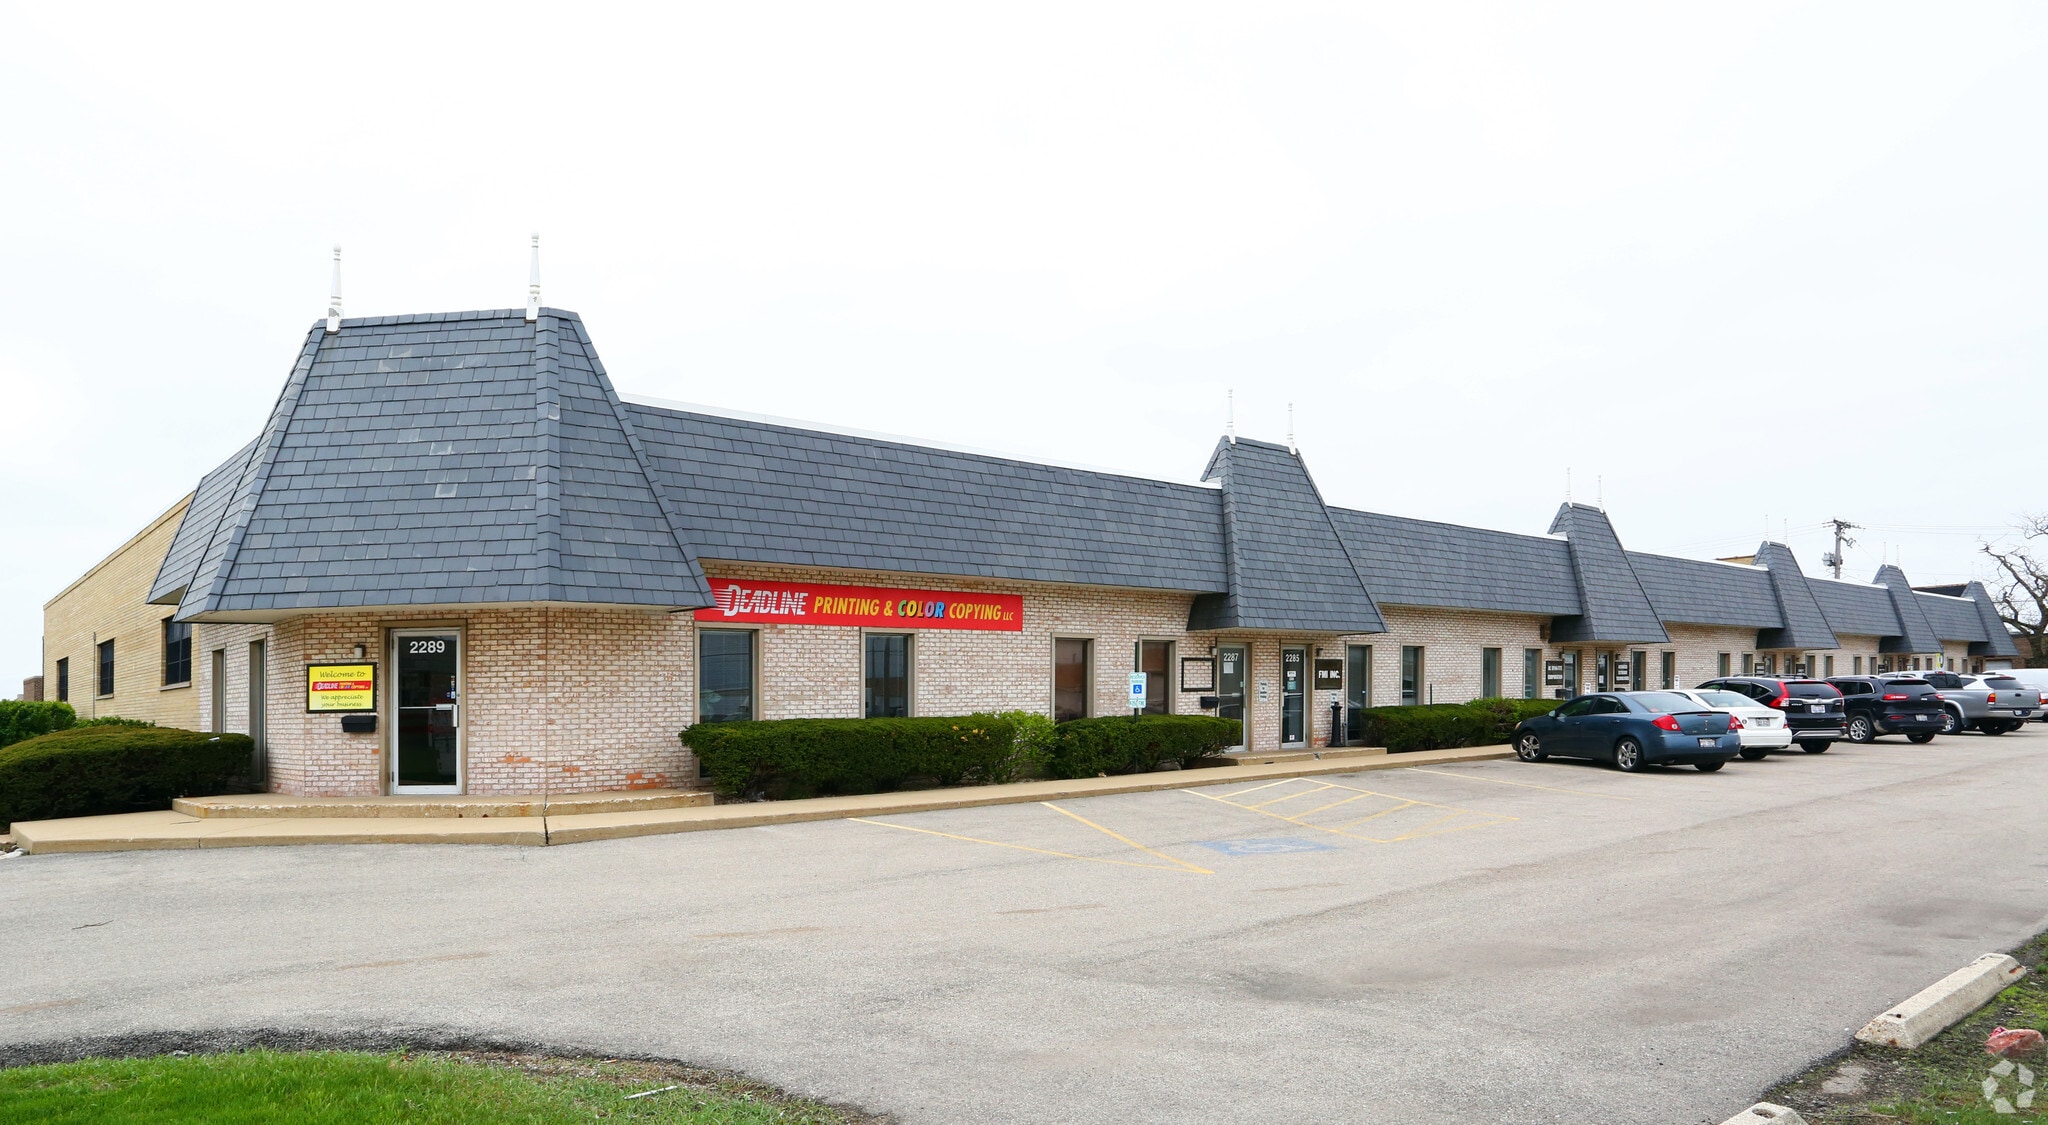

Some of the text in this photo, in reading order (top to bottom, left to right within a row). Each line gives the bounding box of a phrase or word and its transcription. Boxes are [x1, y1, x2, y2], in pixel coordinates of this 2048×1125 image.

[723, 584, 1014, 621] DEADLINE PRINTING & COLOR COPYING LLC
[409, 640, 445, 654] 2289
[1223, 652, 1239, 662] 2287
[1285, 653, 1300, 663] 2285
[319, 670, 366, 678] Welcome to
[1330, 670, 1341, 678] INC.
